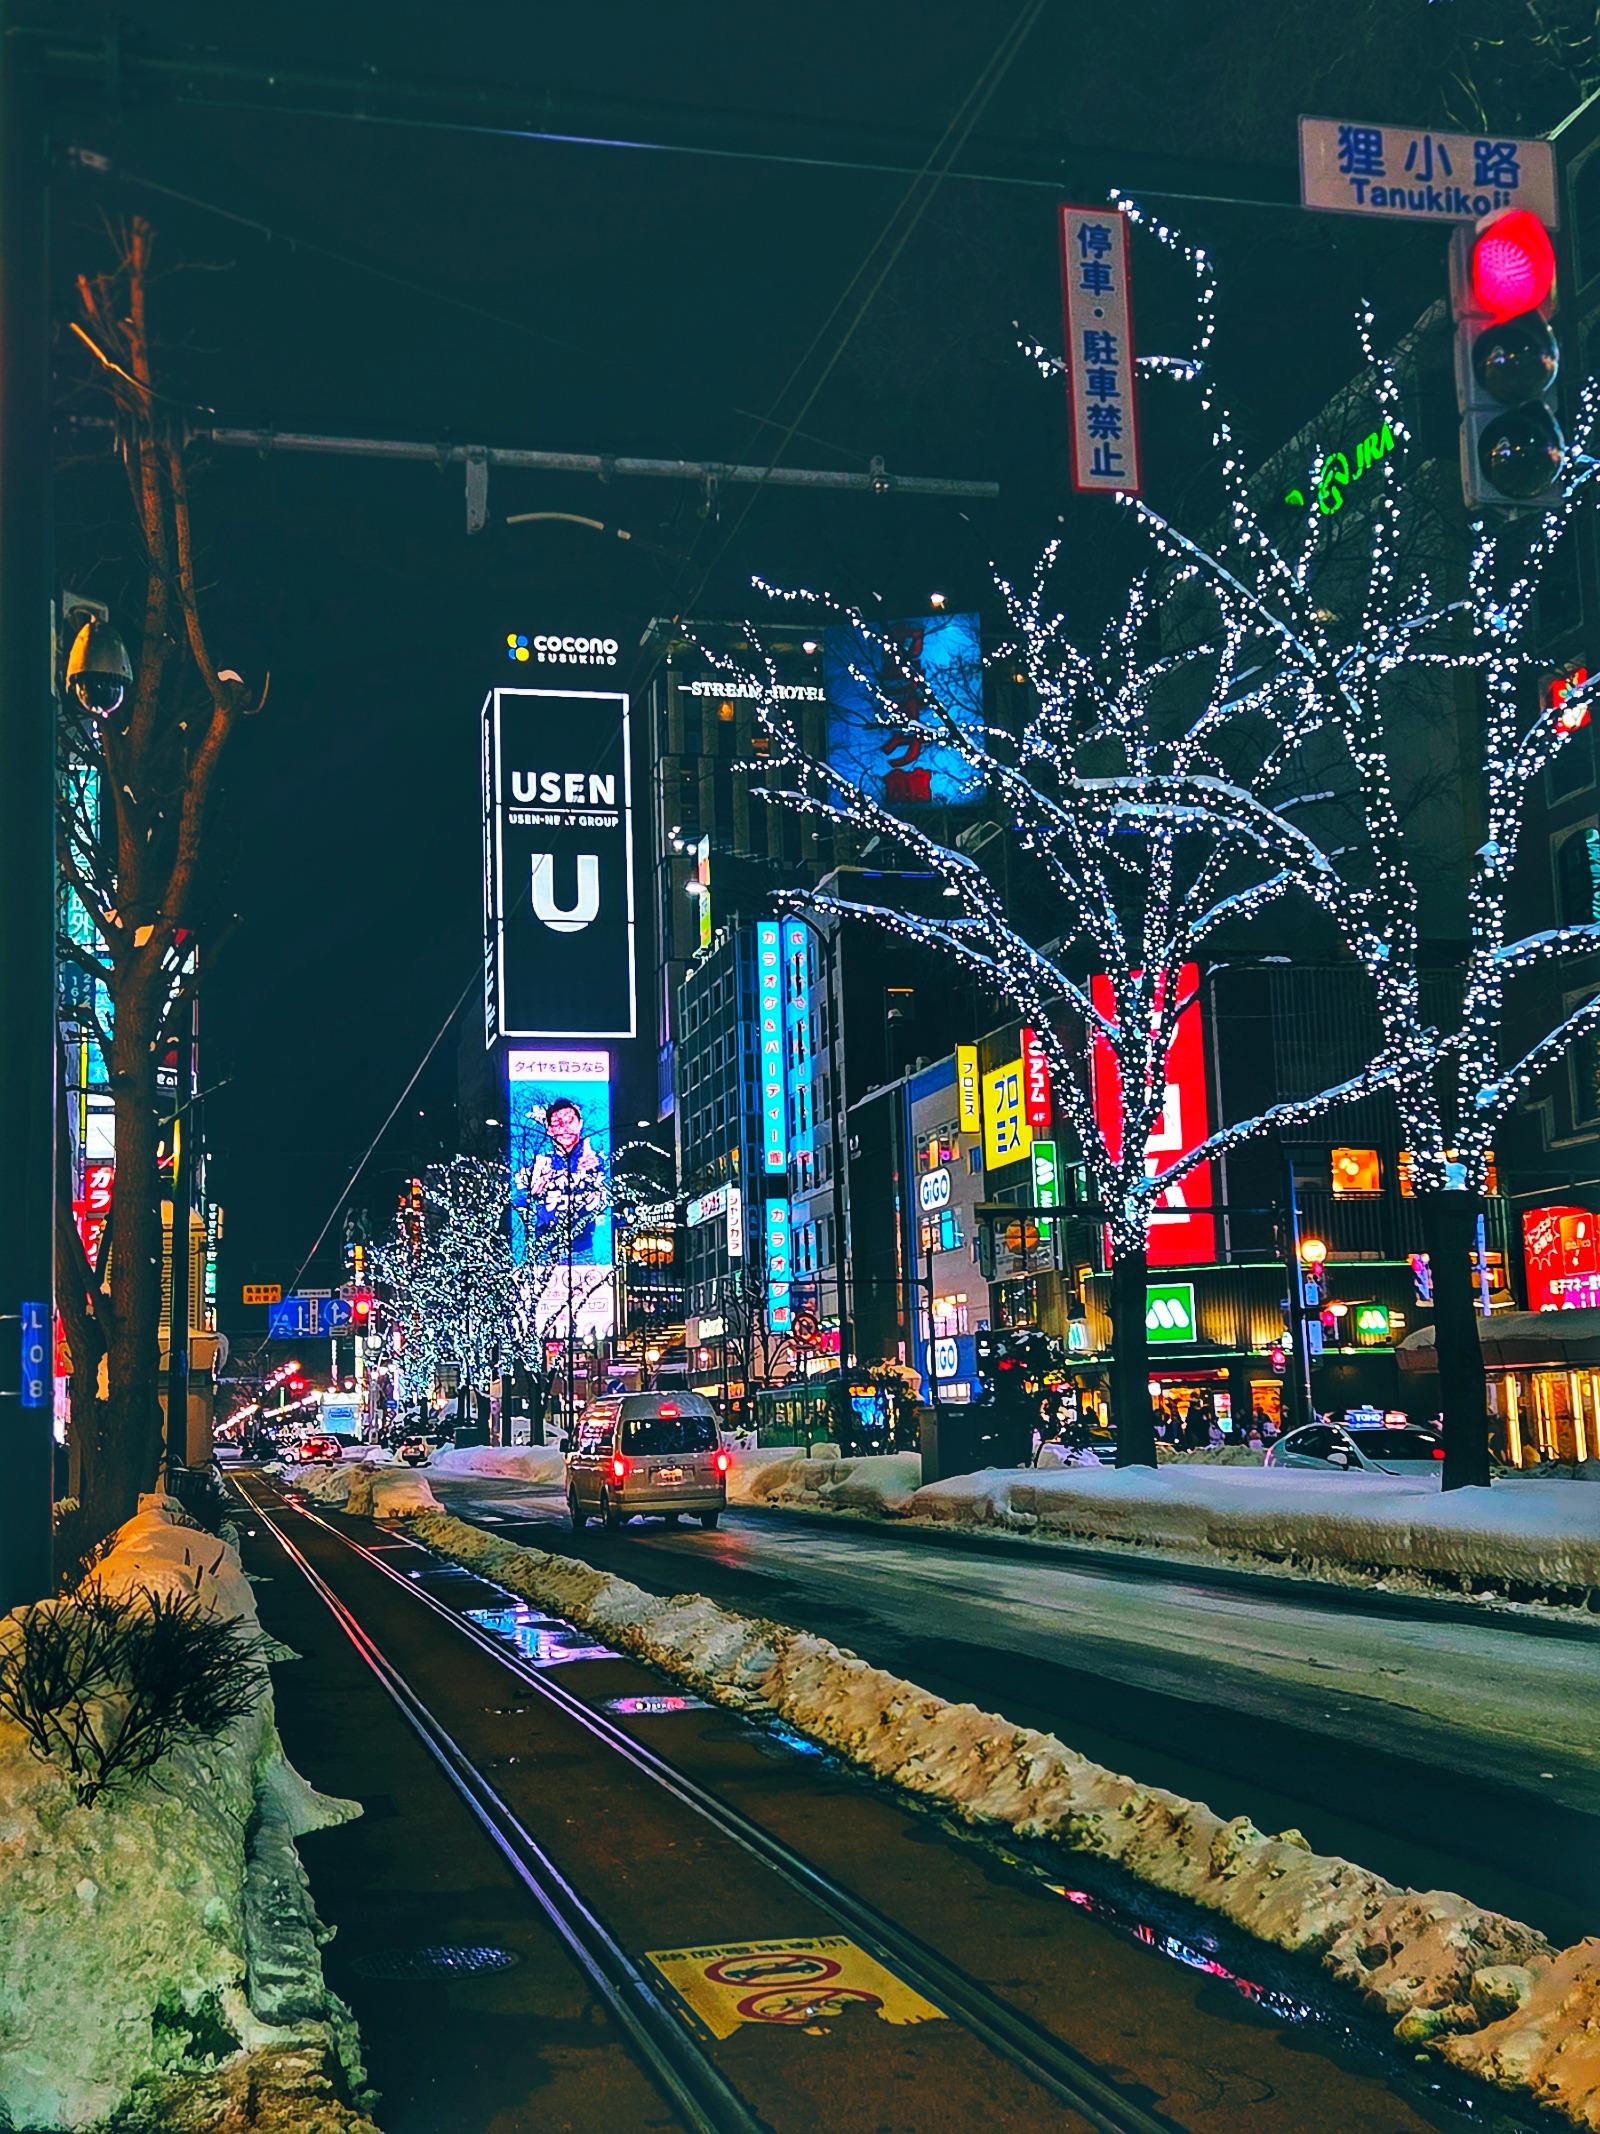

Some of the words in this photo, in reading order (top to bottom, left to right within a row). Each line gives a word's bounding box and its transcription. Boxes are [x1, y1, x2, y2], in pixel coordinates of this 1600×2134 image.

[1338, 125, 1520, 190] 狸小路
[1077, 222, 1126, 478] 停車・駐車禁止
[511, 770, 615, 805] USEN
[578, 816, 619, 828] GROUP
[514, 1061, 605, 1073] タイヤを買うなら
